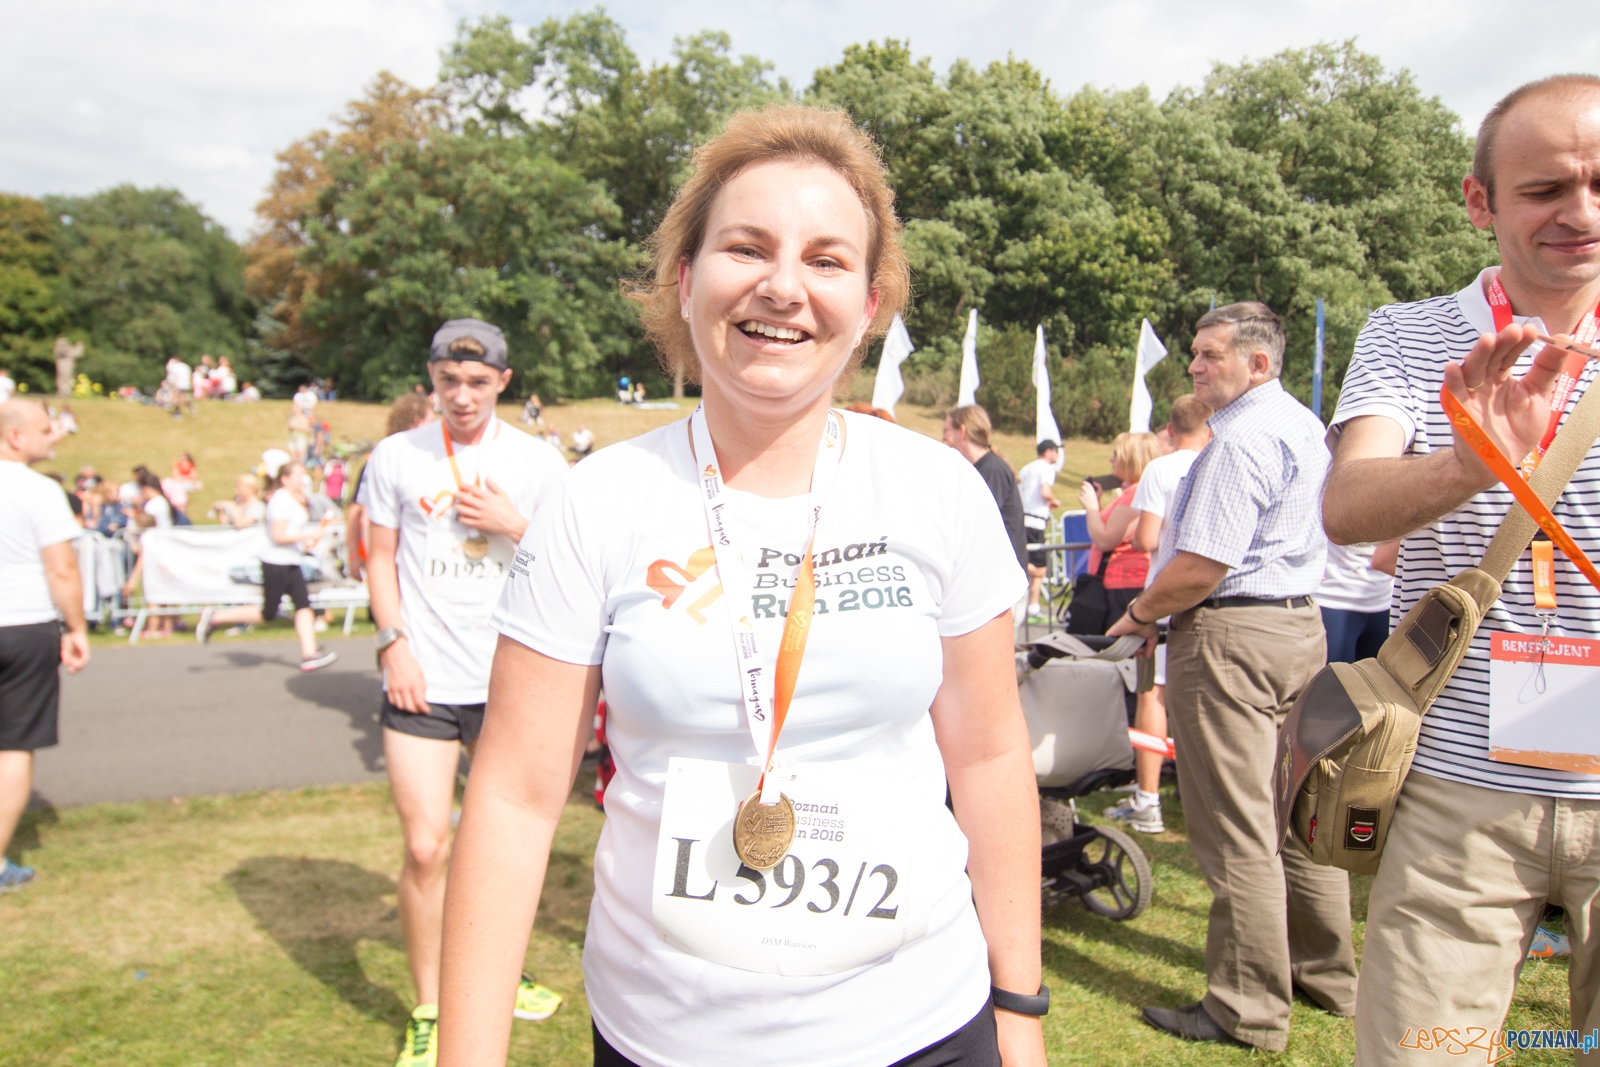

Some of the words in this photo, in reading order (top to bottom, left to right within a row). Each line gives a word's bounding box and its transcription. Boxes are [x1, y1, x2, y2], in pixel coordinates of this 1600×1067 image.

[430, 559, 446, 577] D
[837, 585, 913, 612] 2016
[1502, 639, 1591, 658] BENEFCJENT
[809, 828, 845, 842] 2016
[664, 837, 718, 901] L
[733, 854, 899, 920] 593/2
[761, 936, 782, 946] DSM
[784, 939, 818, 951] Warriors
